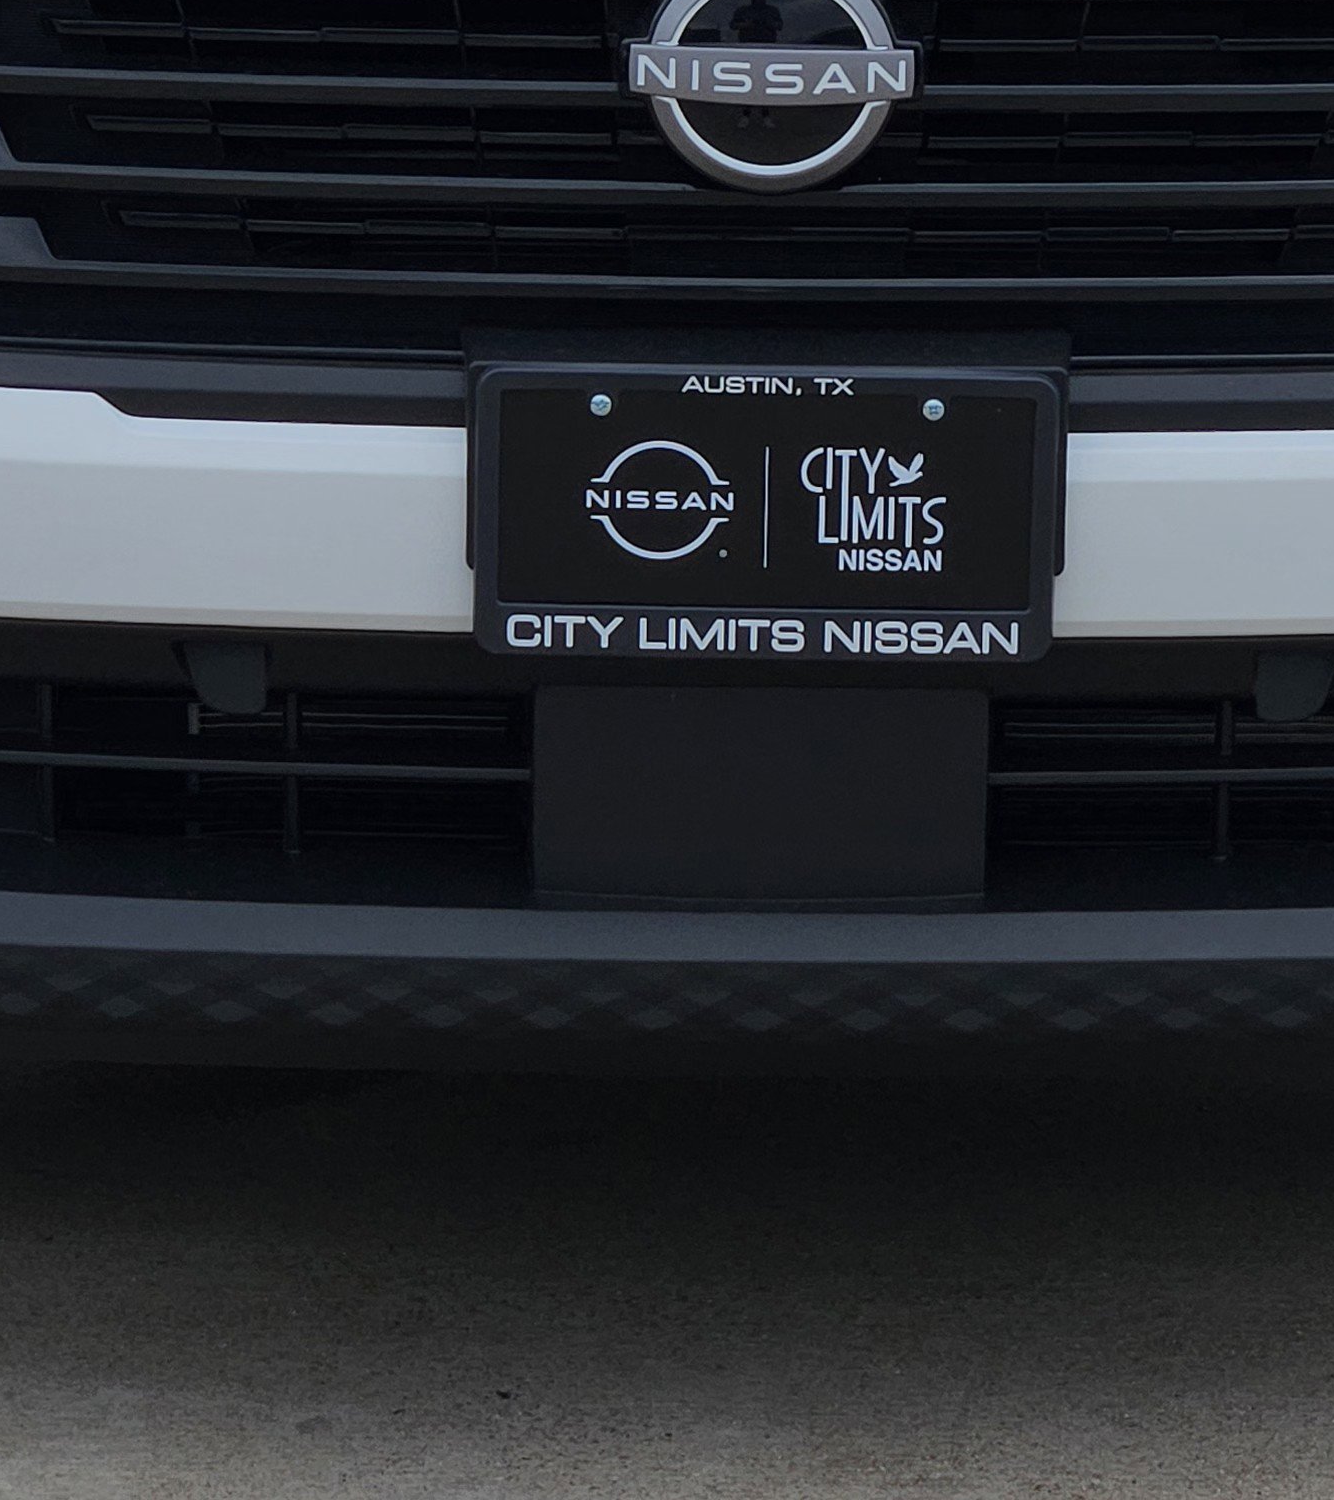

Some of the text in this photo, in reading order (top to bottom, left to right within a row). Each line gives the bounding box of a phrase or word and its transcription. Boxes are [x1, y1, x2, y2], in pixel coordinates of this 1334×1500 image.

[636, 53, 907, 95] NISSAN
[681, 375, 855, 396] AUSTIN, TX
[800, 446, 886, 500] CITY
[585, 488, 735, 511] NISSAN
[817, 494, 947, 548] LIMITS
[838, 548, 943, 572] NISSAN
[506, 613, 1019, 655] CITY LIMITS NISSAN
